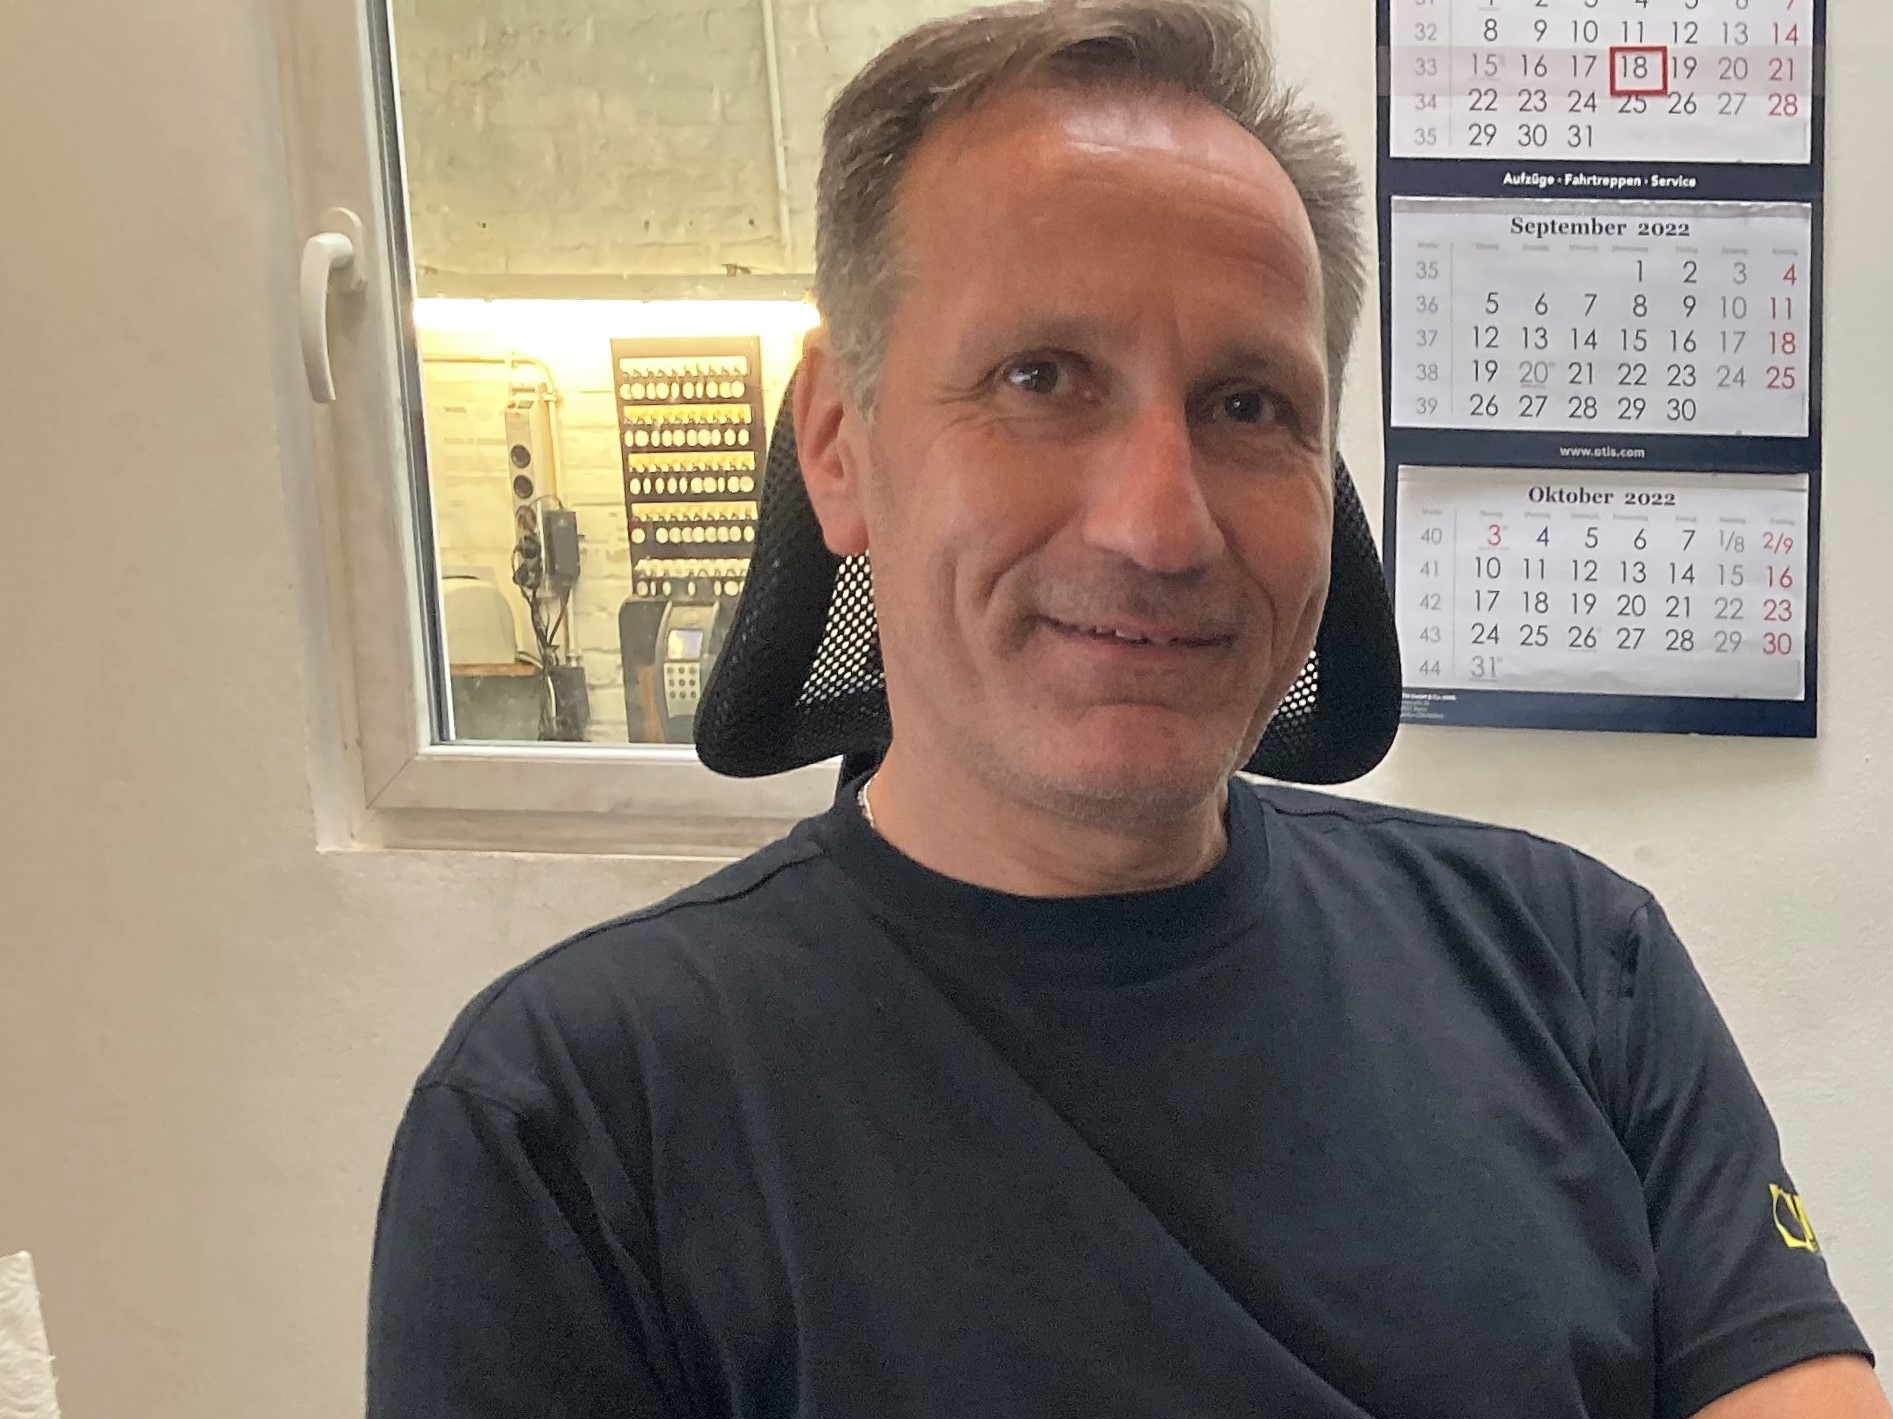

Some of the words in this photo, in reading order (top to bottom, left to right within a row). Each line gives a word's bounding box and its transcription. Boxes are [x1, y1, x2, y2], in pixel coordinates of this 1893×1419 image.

[1414, 22, 1439, 42] 32
[1483, 18, 1499, 42] 8
[1533, 19, 1549, 42] 9
[1570, 19, 1600, 43] 10
[1620, 20, 1646, 44] 11
[1670, 21, 1699, 46] 12
[1720, 21, 1750, 46] 13
[1771, 21, 1800, 46] 14
[1414, 57, 1439, 77] 33
[1521, 53, 1549, 78] 16
[1570, 54, 1597, 79] 17
[1619, 55, 1649, 80] 18
[1670, 56, 1698, 81] 19
[1718, 57, 1749, 82] 20
[1768, 57, 1797, 83] 21
[1414, 92, 1439, 111] 34
[1467, 87, 1499, 112] 22
[1517, 88, 1549, 113] 23
[1567, 90, 1598, 115] 24
[1617, 94, 1648, 115] 25
[1667, 91, 1698, 116] 26
[1718, 92, 1748, 117] 27
[1768, 92, 1799, 118] 28
[1414, 127, 1439, 146] 35
[1467, 122, 1498, 147] 29
[1517, 123, 1549, 148] 30
[1567, 124, 1595, 149] 31
[1502, 172, 1555, 189] Aufzüge
[1563, 173, 1642, 191] Fahrtreppen
[1650, 174, 1697, 189] Service
[1509, 216, 1628, 238] September
[1637, 222, 1691, 237] 2022
[1415, 260, 1439, 280] 35
[1634, 260, 1645, 283] 1
[1682, 260, 1698, 284] 2
[1732, 261, 1748, 285] 3
[1782, 262, 1798, 285] 4
[1415, 294, 1439, 313] 36
[1484, 292, 1500, 316] 5
[1534, 293, 1549, 316] 6
[1583, 293, 1598, 317] 7
[1632, 293, 1648, 318] 8
[1682, 294, 1697, 318] 9
[1719, 296, 1748, 320] 10
[1769, 296, 1794, 321] 11
[1415, 329, 1439, 348] 37
[1471, 325, 1500, 349] 12
[1521, 326, 1549, 350] 13
[1570, 327, 1599, 352] 14
[1619, 328, 1648, 352] 15
[1669, 329, 1697, 354] 16
[1719, 330, 1746, 354] 17
[1769, 331, 1797, 356] 18
[1415, 363, 1439, 382] 38
[1472, 359, 1499, 383] 19
[1567, 361, 1595, 386] 21
[1617, 362, 1648, 387] 22
[1666, 363, 1697, 388] 23
[1715, 365, 1746, 389] 24
[1765, 365, 1797, 390] 25
[1415, 397, 1439, 416] 39
[1469, 393, 1500, 418] 26
[1518, 395, 1549, 418] 27
[1567, 396, 1598, 420] 28
[1617, 397, 1647, 421] 29
[1666, 398, 1697, 422] 30
[1559, 446, 1646, 459] www.otis.com
[1527, 485, 1615, 507] Oktober
[1623, 491, 1677, 507] 2022
[1419, 527, 1444, 545] 40
[1535, 525, 1550, 548] 4
[1584, 526, 1599, 550] 5
[1633, 527, 1648, 551] 6
[1681, 529, 1697, 552] 7
[1418, 561, 1439, 579] 41
[1474, 556, 1502, 580] 10
[1523, 557, 1546, 581] 11
[1571, 558, 1599, 583] 12
[1619, 560, 1648, 585] 13
[1668, 561, 1697, 586] 14
[1716, 563, 1745, 587] 15
[1766, 564, 1794, 589] 16
[1418, 594, 1443, 611] 42
[1473, 589, 1500, 614] 17
[1522, 591, 1549, 615] 18
[1570, 592, 1597, 616] 19
[1616, 593, 1647, 618] 20
[1664, 594, 1691, 619] 21
[1713, 596, 1745, 621] 22
[1762, 598, 1793, 623] 23
[1418, 627, 1442, 644] 43
[1470, 622, 1500, 647] 24
[1519, 624, 1549, 648] 25
[1616, 627, 1646, 651] 27
[1664, 628, 1695, 652] 28
[1713, 630, 1743, 655] 29
[1762, 631, 1792, 656] 30
[1417, 660, 1441, 678] 44
